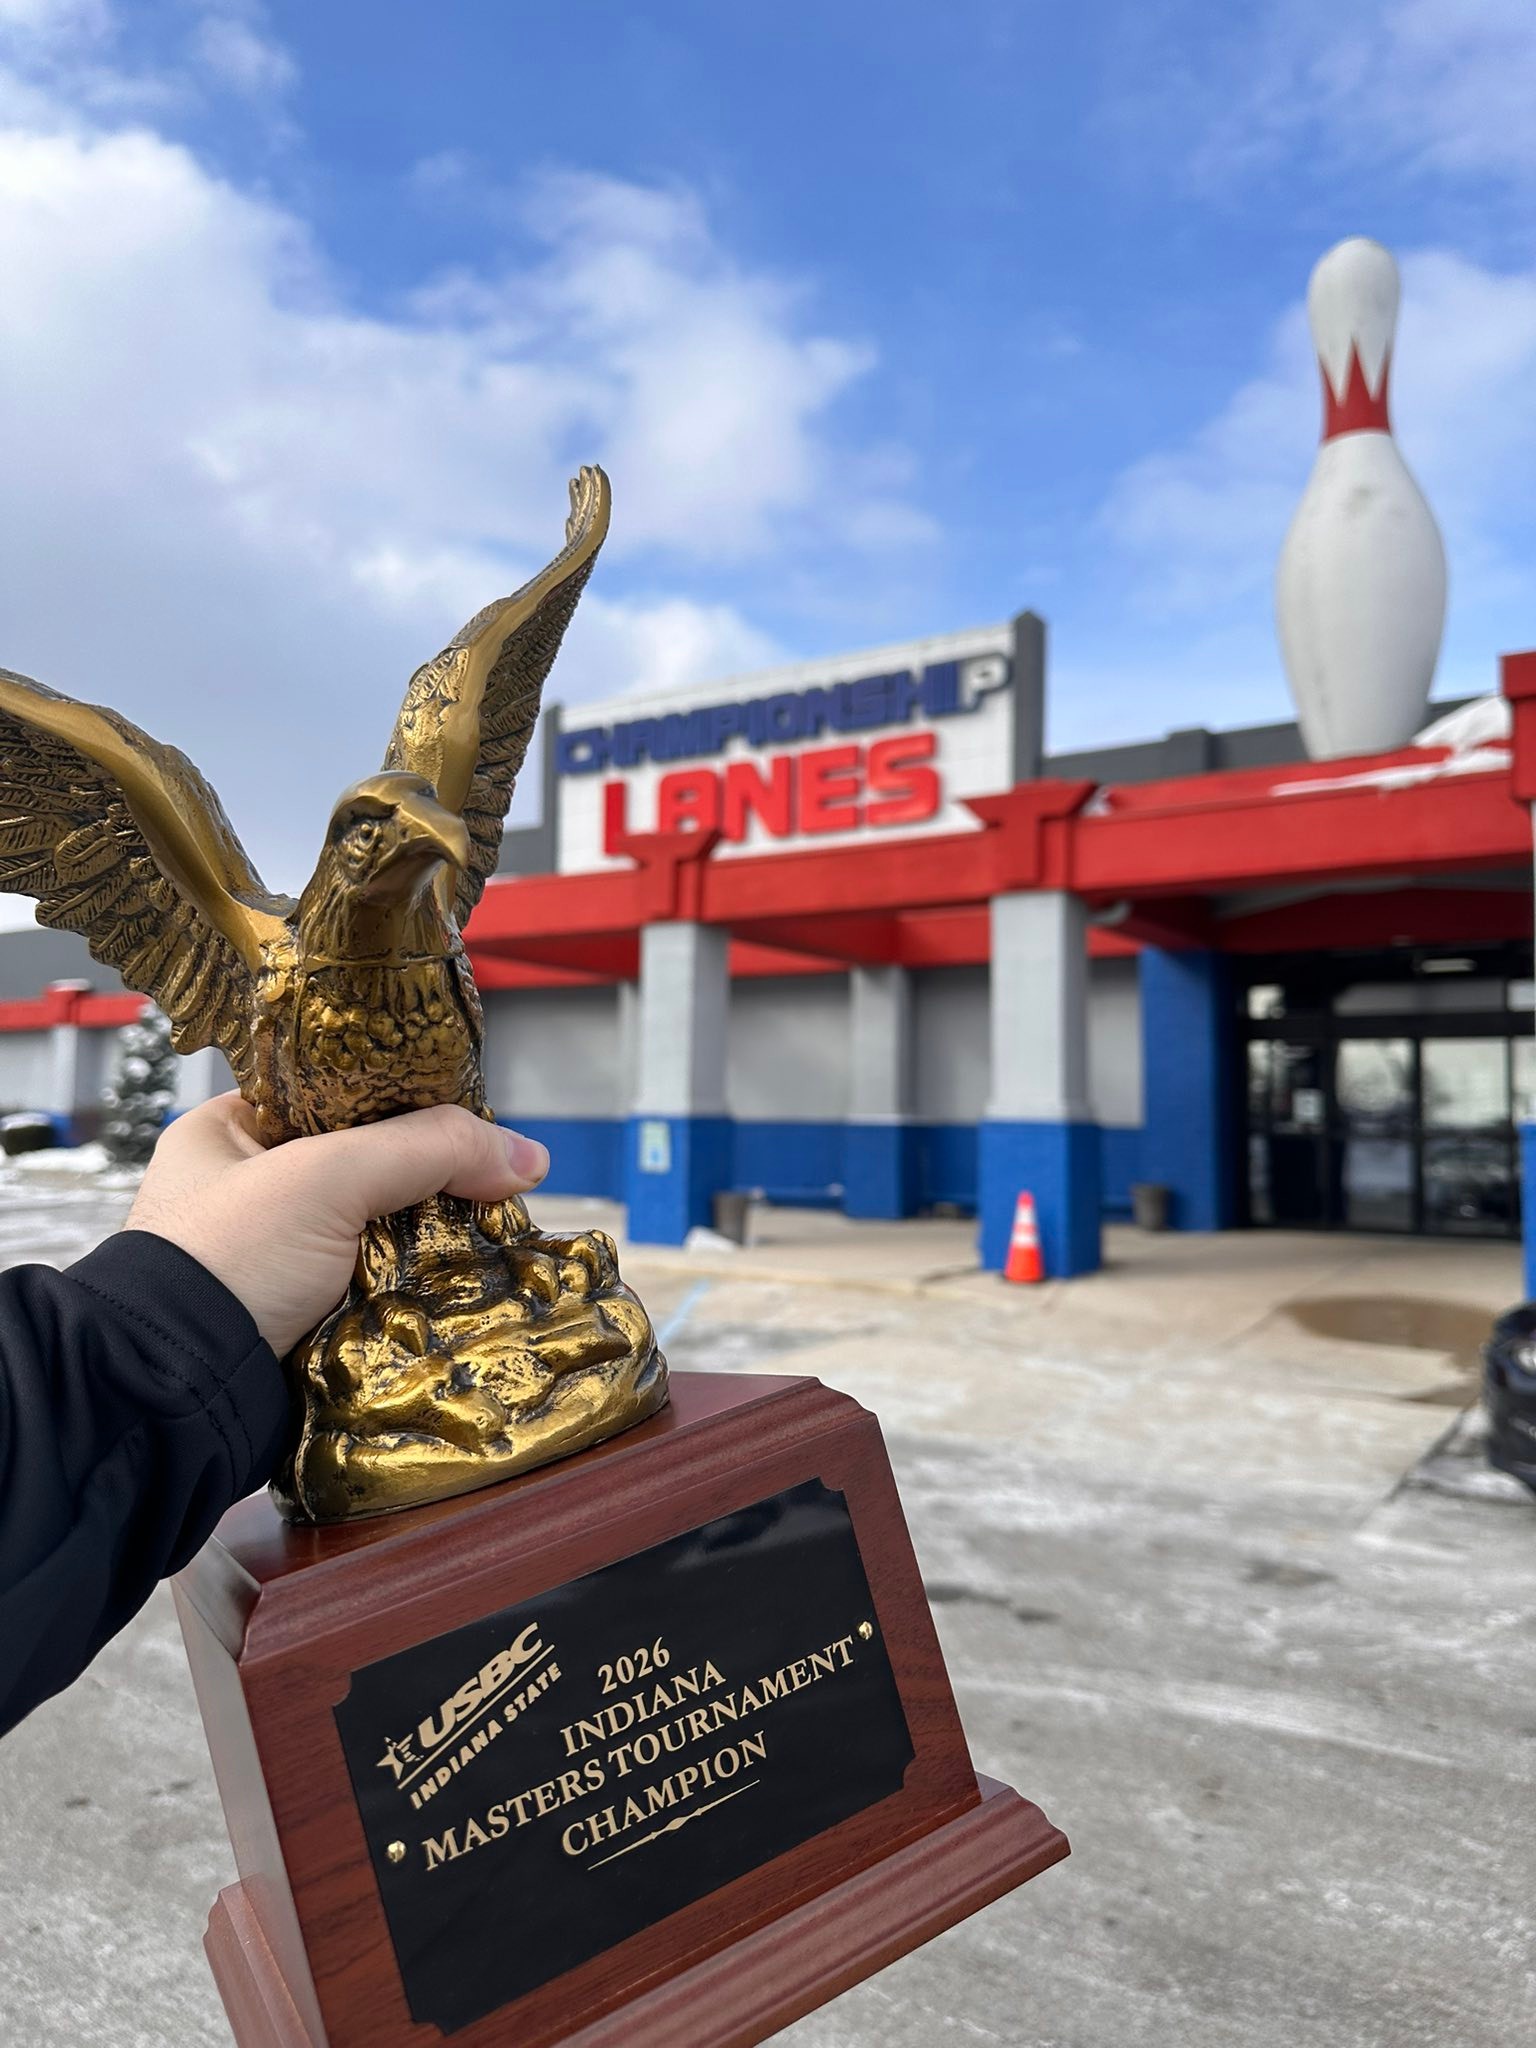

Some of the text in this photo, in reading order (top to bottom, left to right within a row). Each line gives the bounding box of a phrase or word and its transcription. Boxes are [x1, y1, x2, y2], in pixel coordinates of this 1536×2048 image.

[556, 652, 1012, 774] CHAMPIONSHIP
[604, 731, 940, 856] LANES
[418, 1622, 543, 1748] USBC
[560, 1660, 727, 1757] INDIANA
[597, 1637, 671, 1694] 2026
[410, 1662, 562, 1809] INDIANA STATE
[422, 1635, 855, 1871] MASTERS TOURNAMENT
[562, 1731, 768, 1856] CHAMPION
